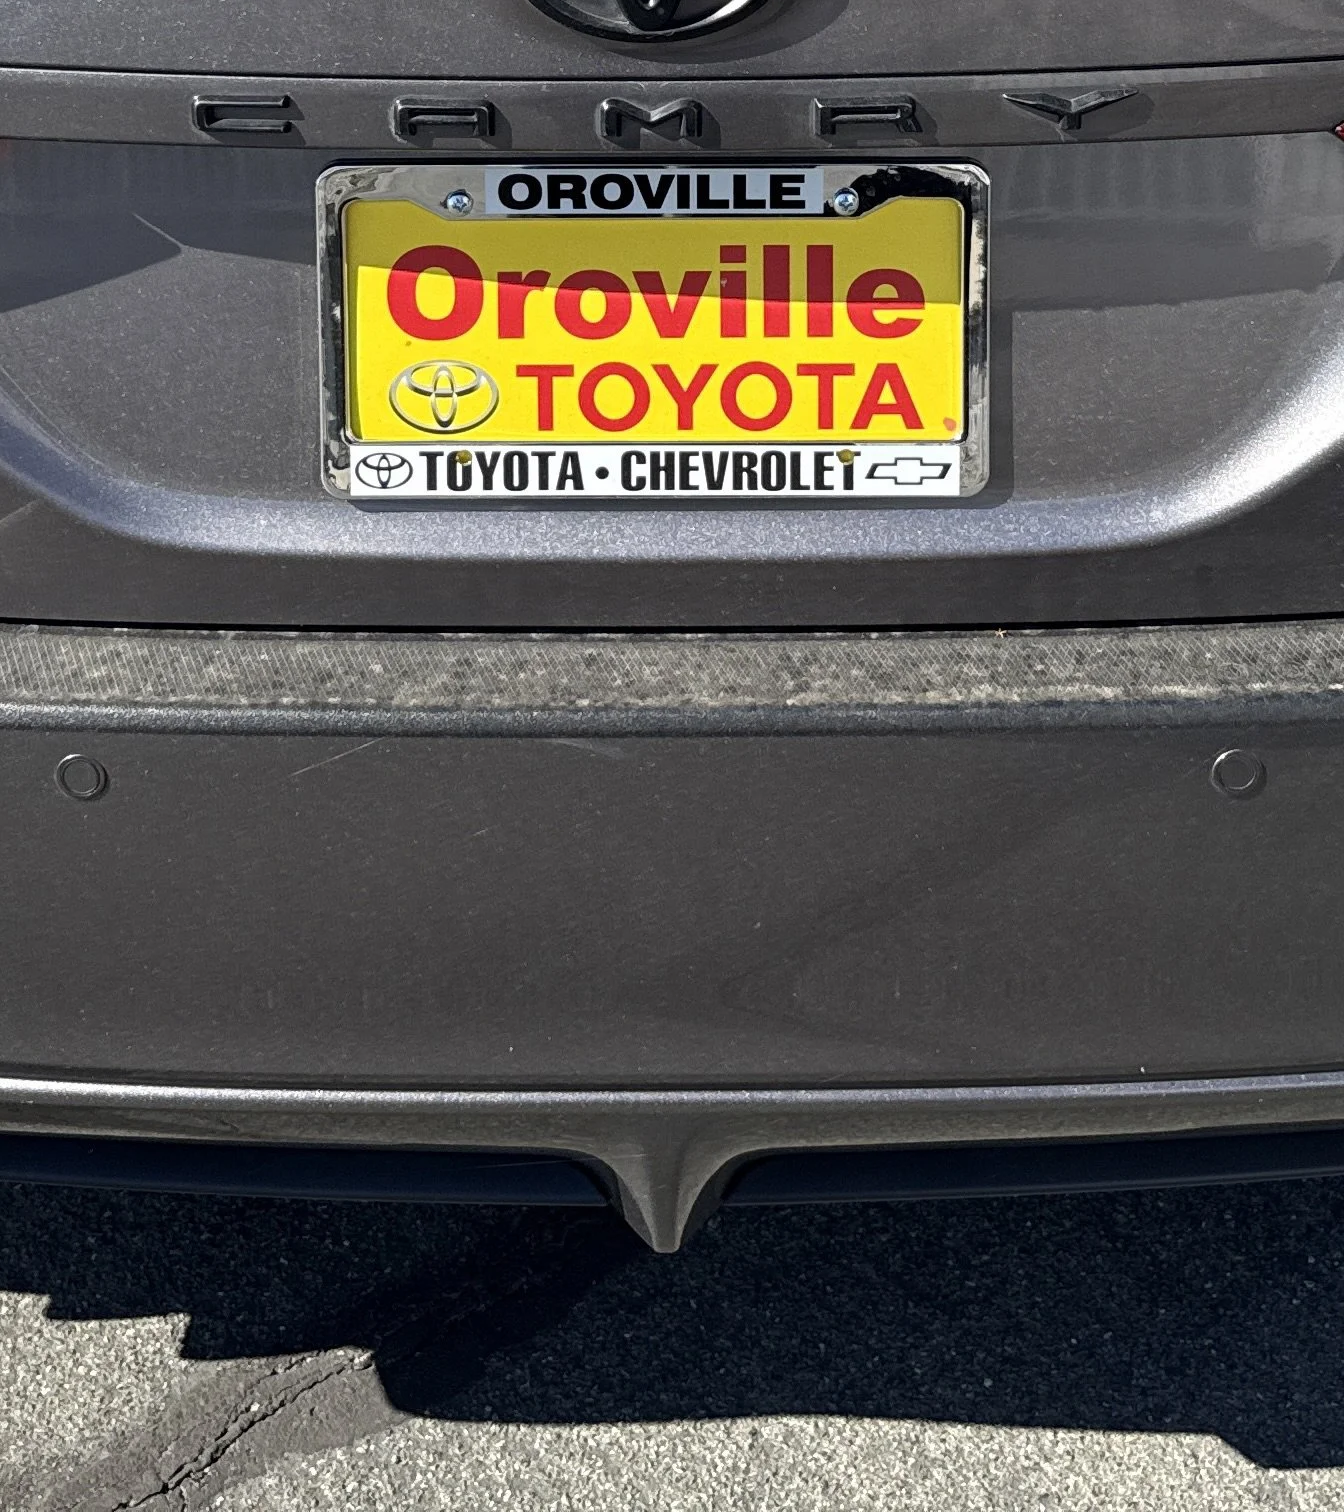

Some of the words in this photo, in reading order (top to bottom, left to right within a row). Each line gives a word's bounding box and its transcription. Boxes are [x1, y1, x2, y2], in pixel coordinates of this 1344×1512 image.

[192, 88, 1141, 138] CAMRY
[496, 172, 807, 211] OROVILLE
[386, 244, 927, 341] Oroville
[515, 360, 926, 433] TOYOTA
[418, 449, 585, 492] TOYOTA
[620, 448, 862, 492] CHEVROLET
